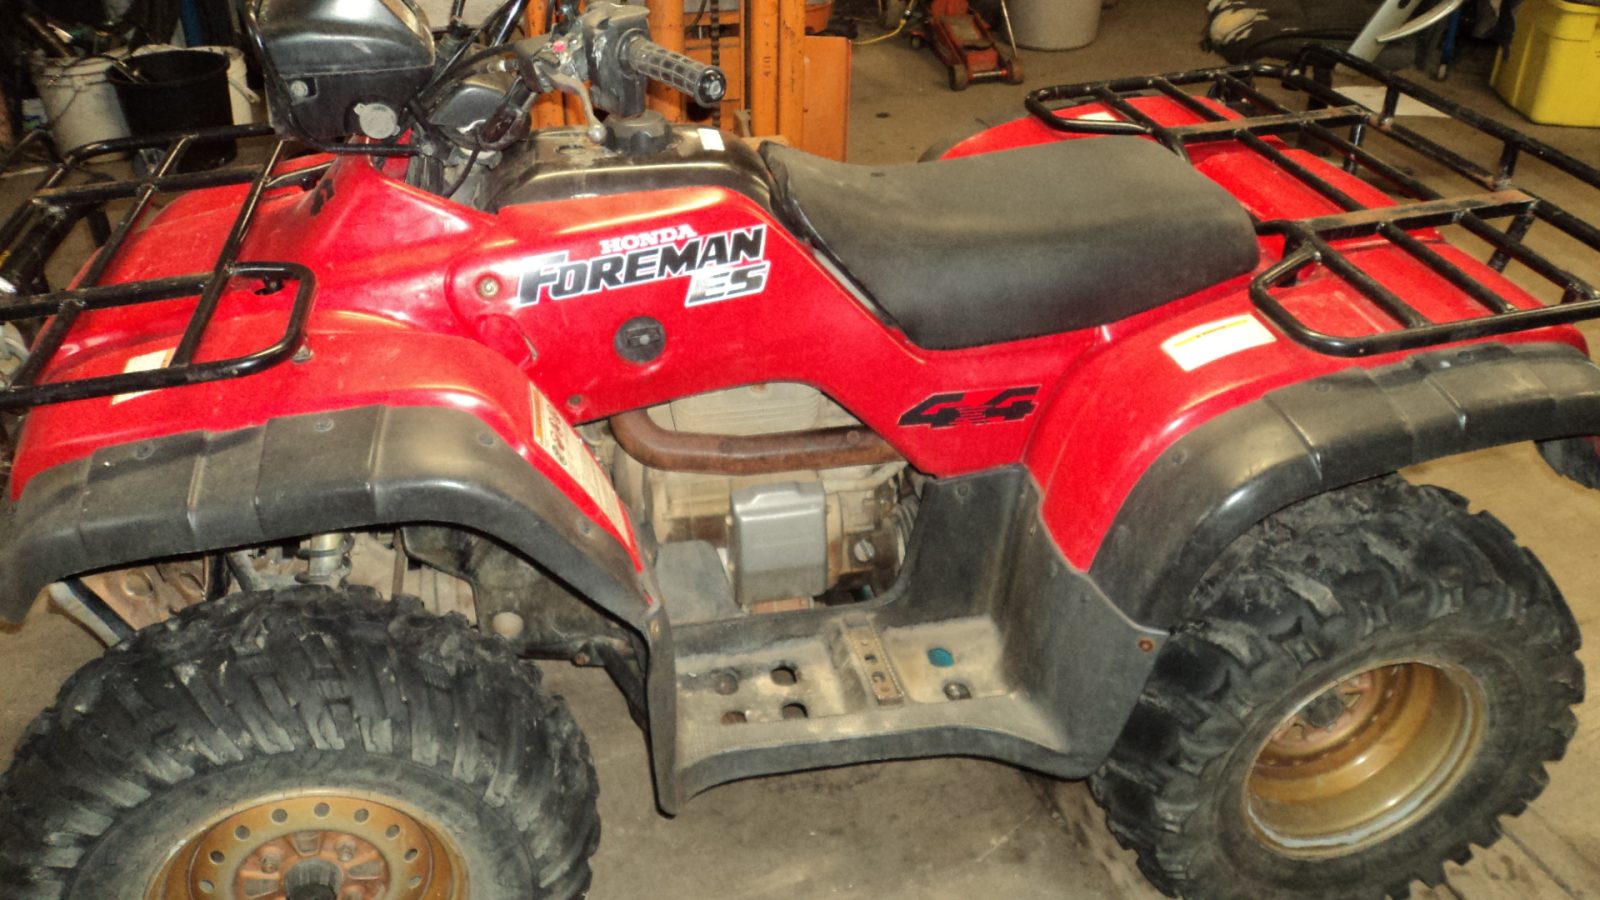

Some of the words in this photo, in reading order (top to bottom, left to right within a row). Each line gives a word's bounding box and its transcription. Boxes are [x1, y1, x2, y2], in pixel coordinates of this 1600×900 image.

[599, 224, 697, 253] HONDA
[517, 225, 767, 307] FOREMAN
[685, 262, 770, 307] ES
